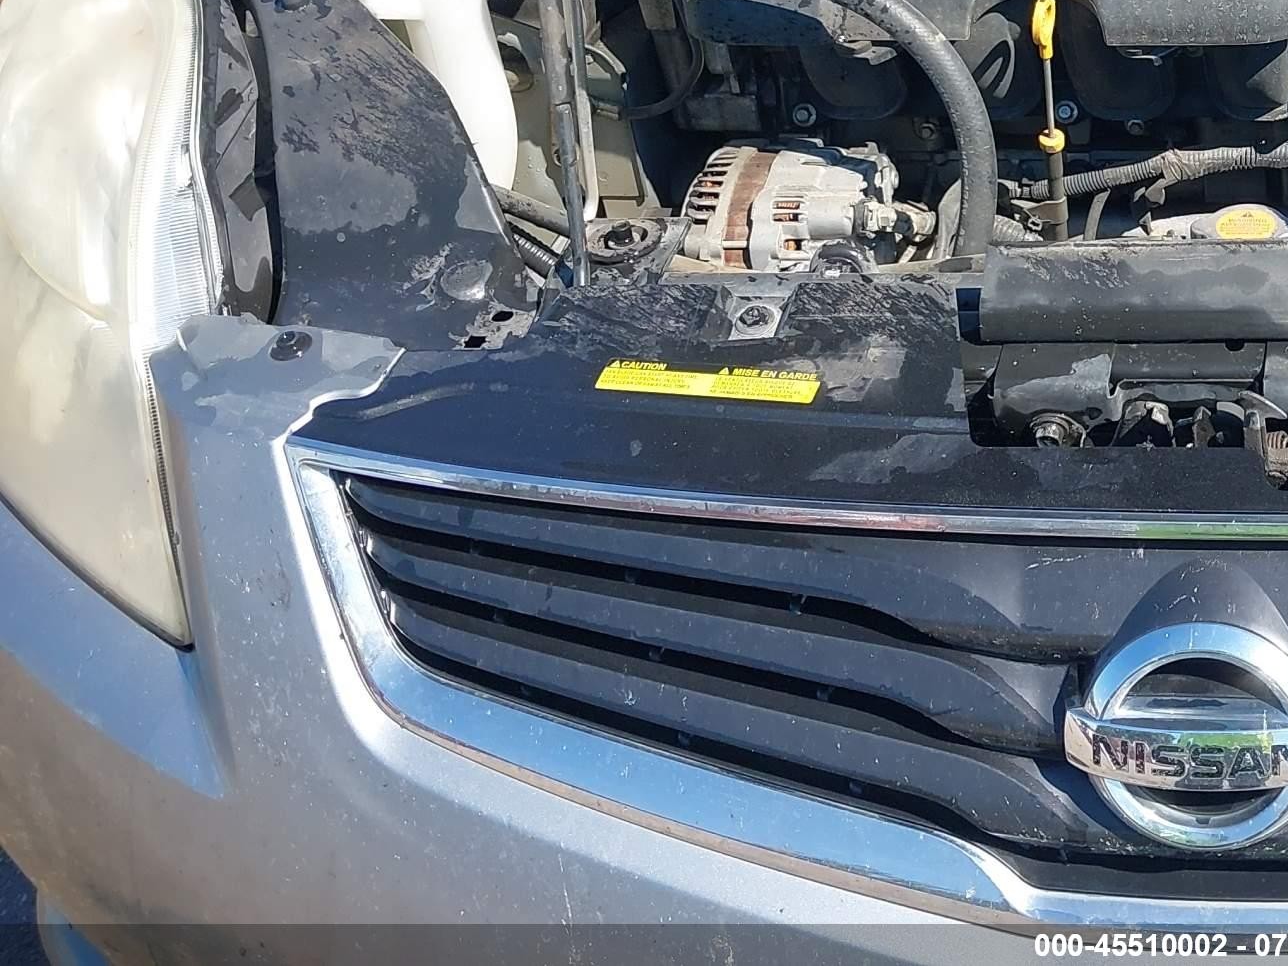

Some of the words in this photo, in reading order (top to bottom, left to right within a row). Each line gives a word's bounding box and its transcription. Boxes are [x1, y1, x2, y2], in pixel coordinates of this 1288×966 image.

[621, 361, 668, 371] CAUTION
[733, 368, 761, 378] MISE
[761, 370, 778, 379] EN
[778, 372, 817, 382] GARDE
